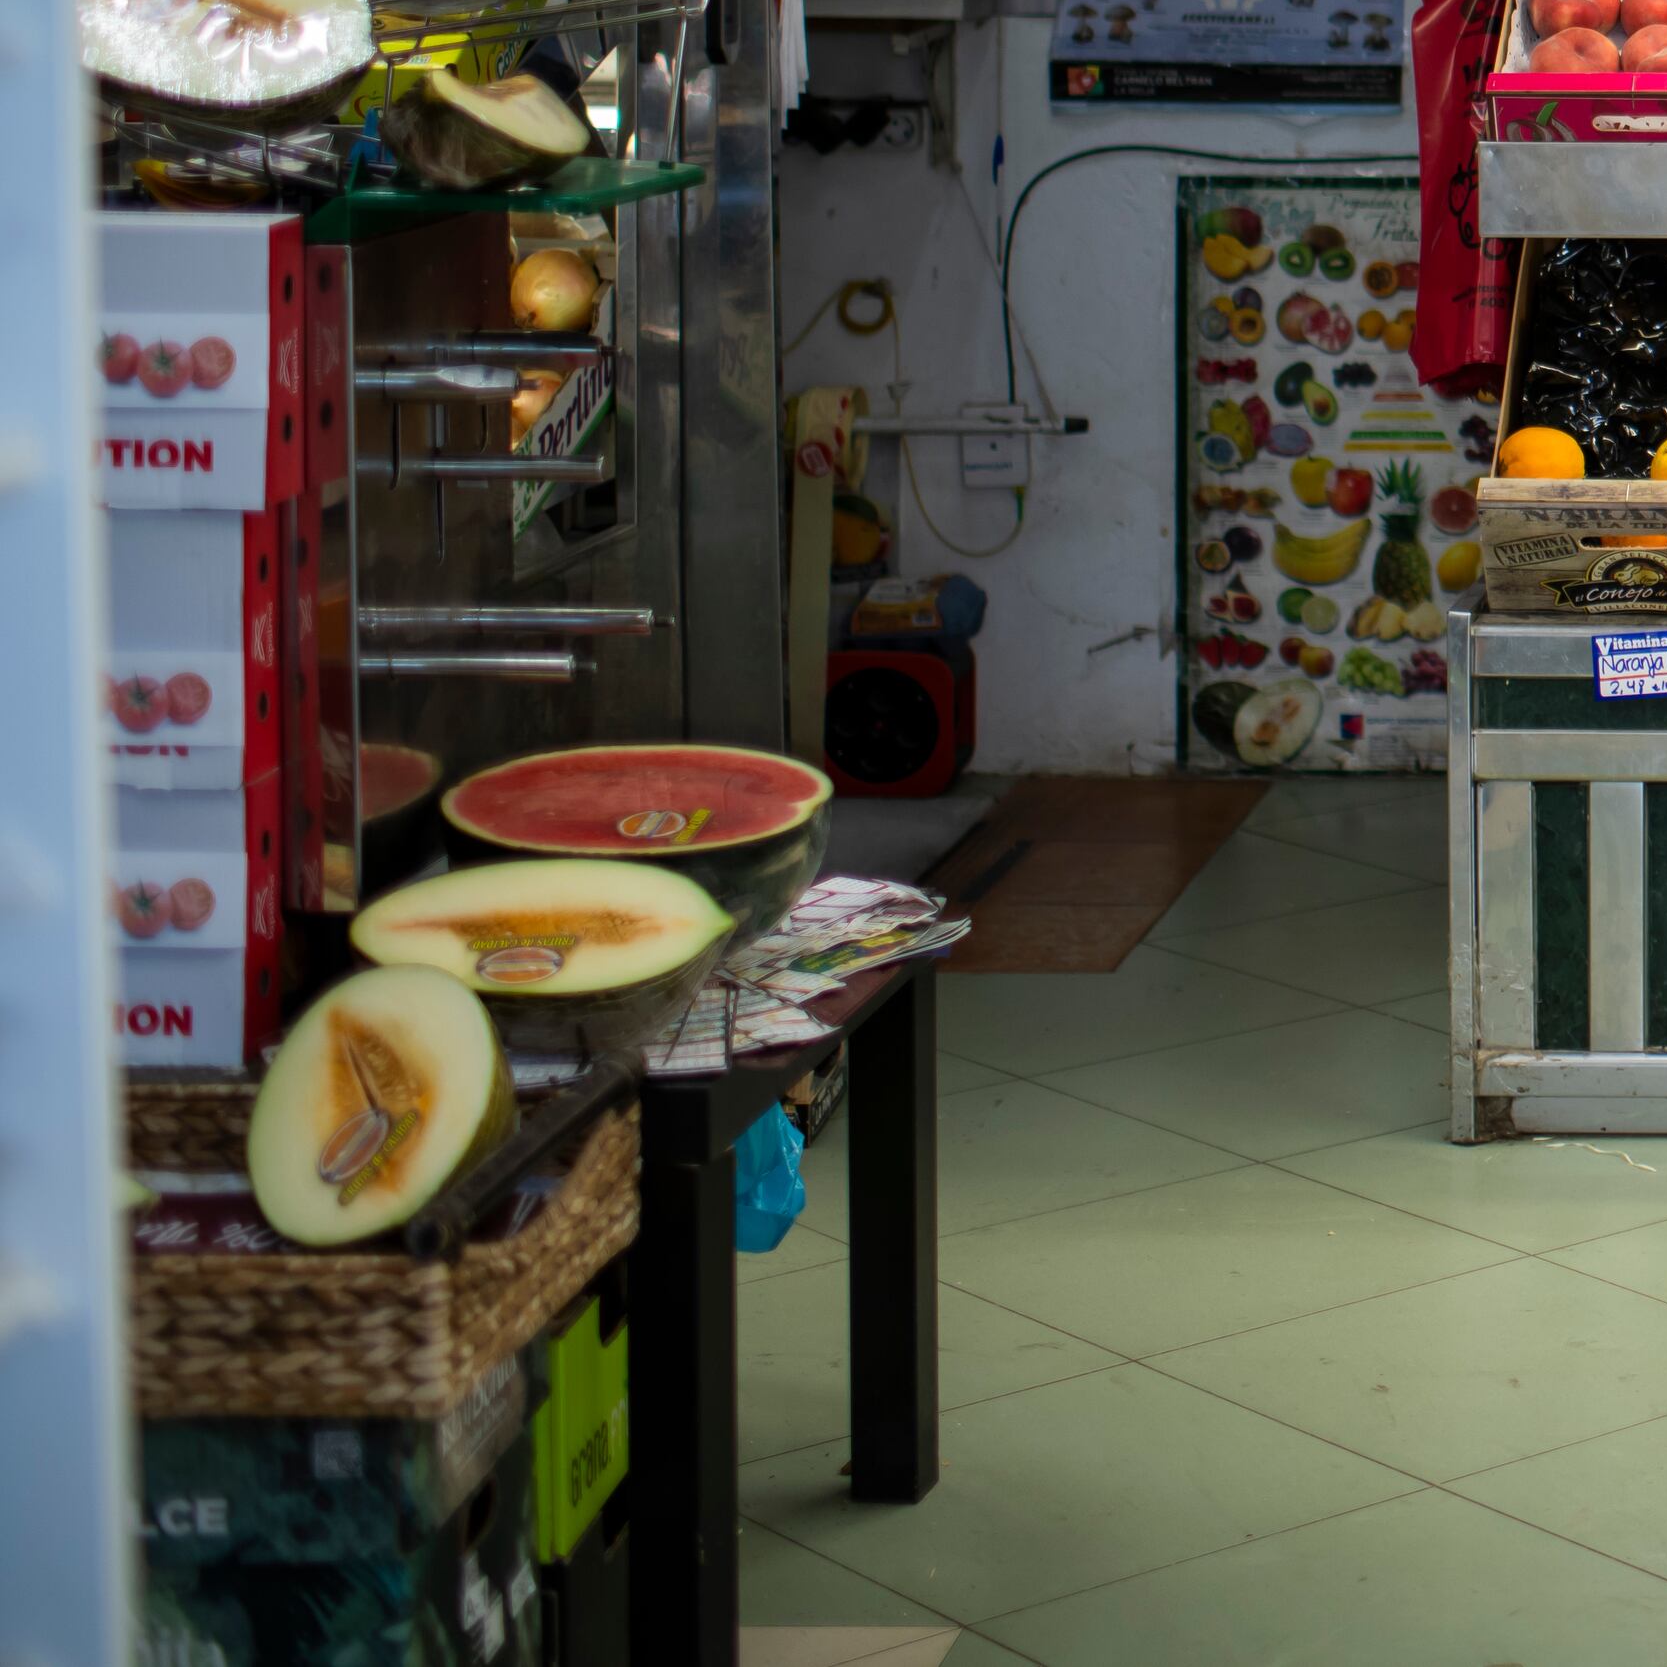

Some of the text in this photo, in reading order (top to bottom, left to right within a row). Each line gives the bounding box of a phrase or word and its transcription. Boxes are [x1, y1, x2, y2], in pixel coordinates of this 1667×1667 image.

[1498, 535, 1571, 556] VITAMINA
[1505, 544, 1574, 565] NATURAL
[1586, 586, 1653, 605] Conejo
[1601, 653, 1664, 678] Naranja
